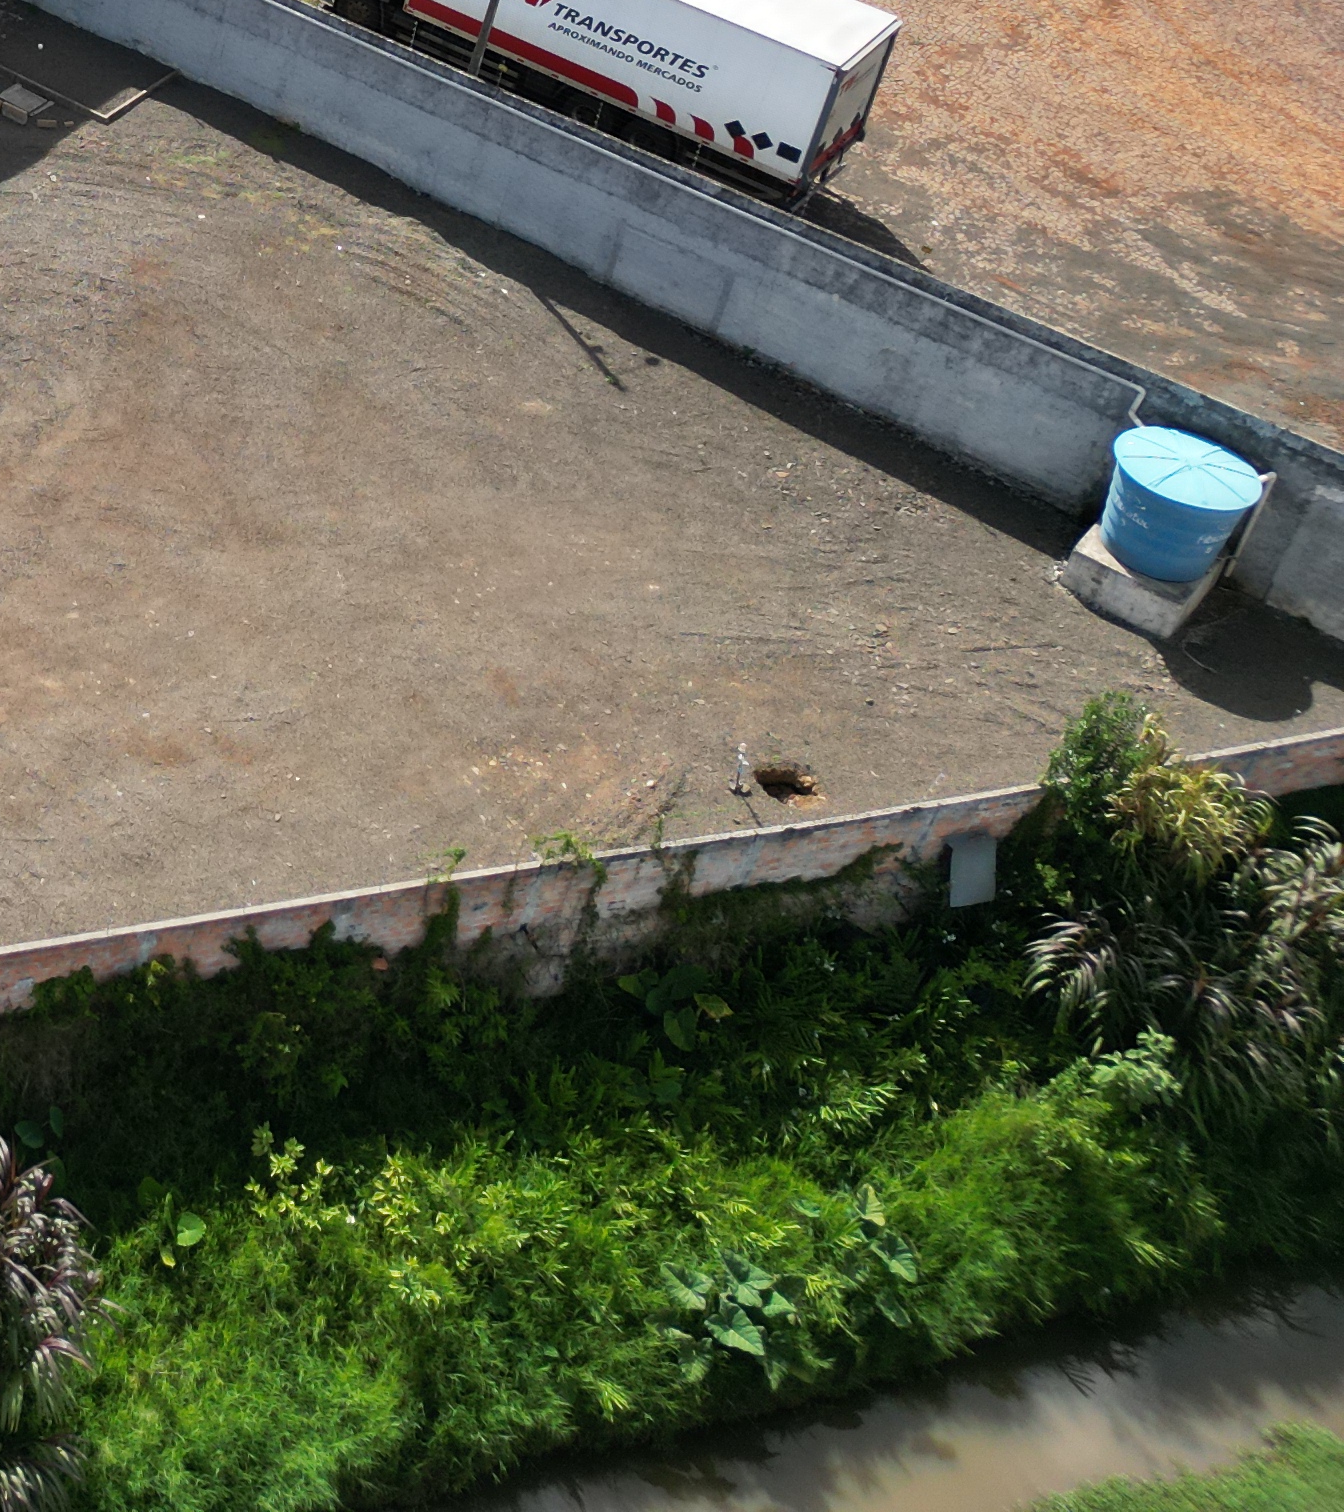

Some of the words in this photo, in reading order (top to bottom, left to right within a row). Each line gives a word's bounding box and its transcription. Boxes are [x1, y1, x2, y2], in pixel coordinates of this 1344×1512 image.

[547, 21, 635, 64] APROXIMANDO
[635, 57, 703, 94] MERCADOS
[553, 2, 710, 80] TRANSPORTES
